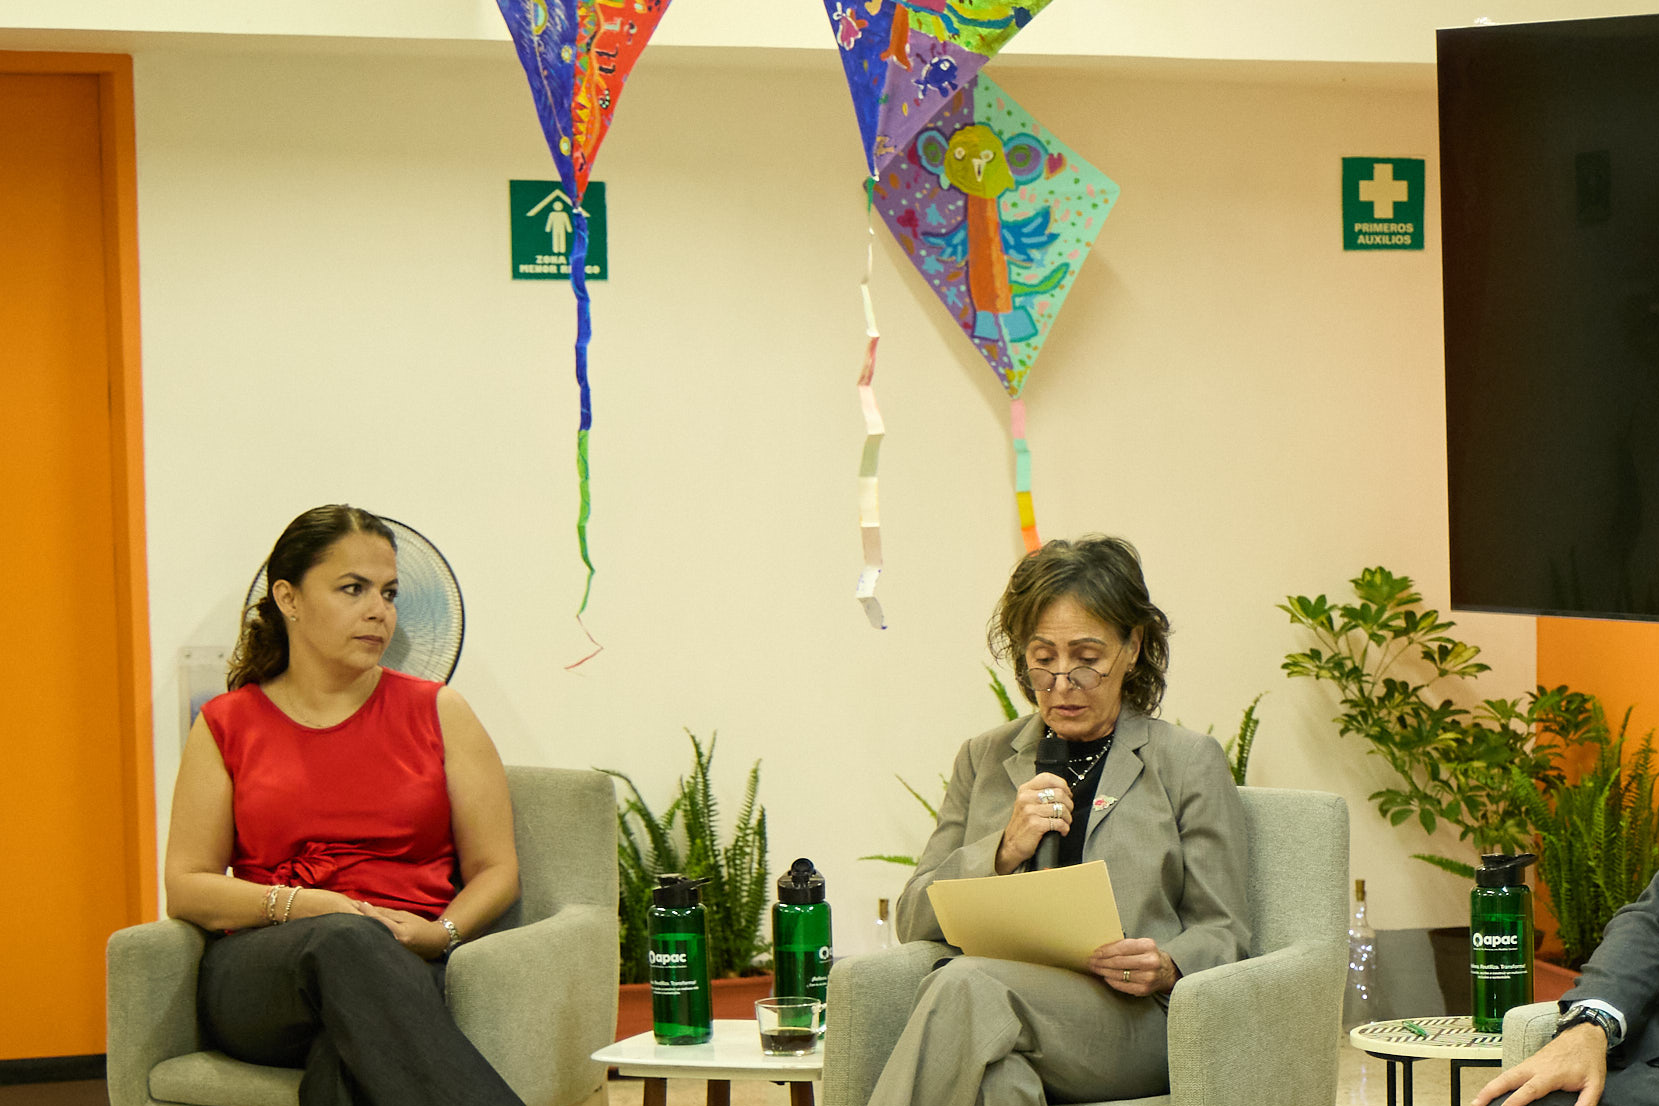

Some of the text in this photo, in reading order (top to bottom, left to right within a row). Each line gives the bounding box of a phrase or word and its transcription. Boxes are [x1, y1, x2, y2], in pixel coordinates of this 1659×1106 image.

[1354, 223, 1414, 233] PRIMEROS
[1357, 234, 1412, 245] AUXILIOS
[535, 254, 567, 264] ZONA
